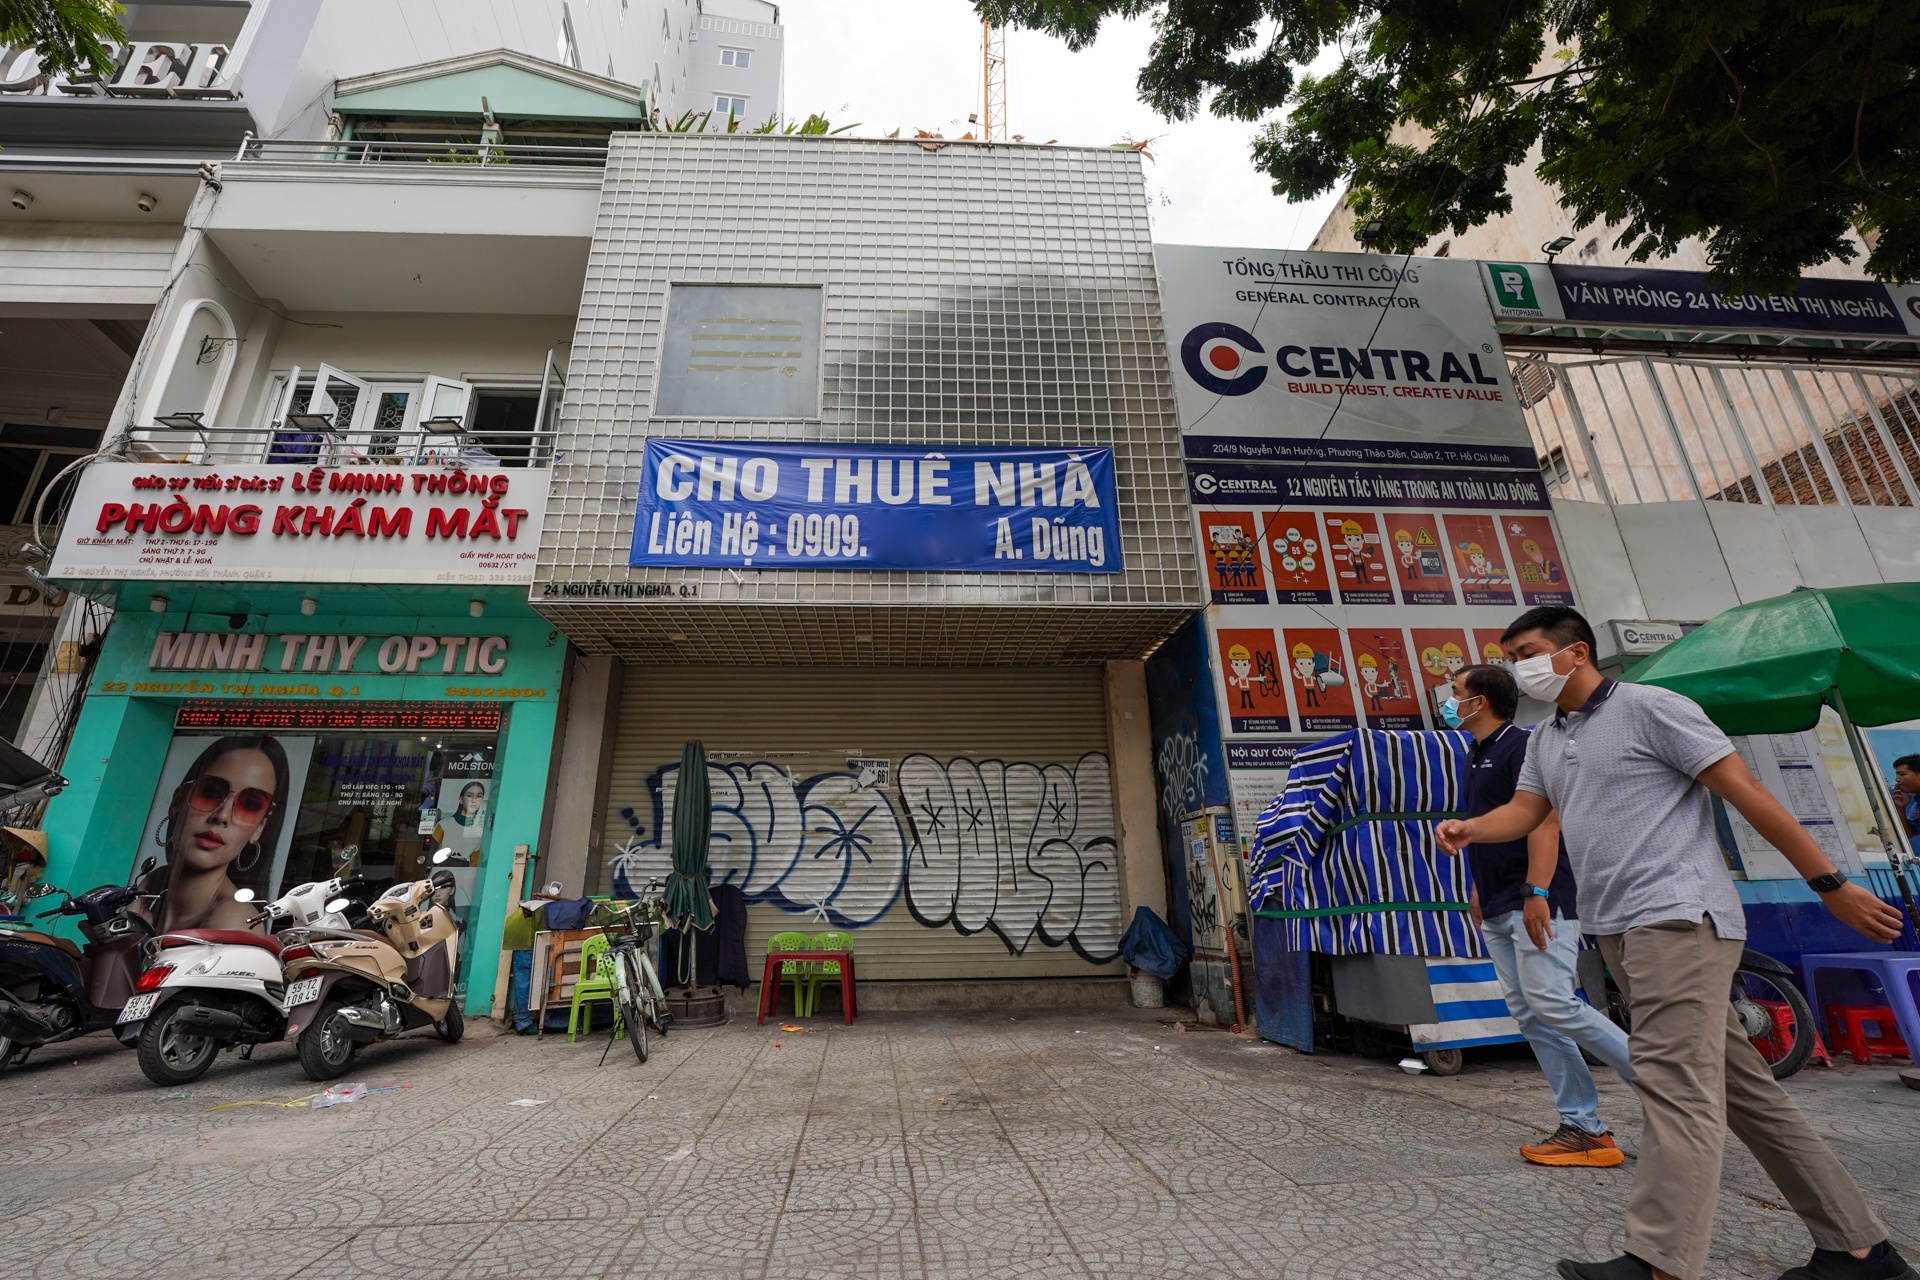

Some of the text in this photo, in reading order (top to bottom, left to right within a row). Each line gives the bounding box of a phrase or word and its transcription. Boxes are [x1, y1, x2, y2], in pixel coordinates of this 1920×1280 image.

[1223, 257, 1419, 283] TỔNG THẦU THI CÔNG
[1236, 290, 1420, 309] GENERAL CONTRACTOR
[1563, 281, 1895, 318] VĂN PHÒNG 24 THỊ NGHĨA
[1501, 308, 1544, 318] PHYTOPHARMA
[1276, 345, 1498, 386] CENTRAL
[1287, 381, 1504, 402] BUILD TRUST, CREATE VALUE
[1212, 444, 1237, 454] 204/9
[1239, 443, 1273, 456] Nguyễn
[1275, 446, 1292, 455] Văn
[1328, 446, 1363, 459] Phường
[1363, 448, 1385, 459] Thảo
[1387, 449, 1410, 460] Điền,
[1411, 450, 1434, 462] Quận
[1435, 451, 1443, 461] 2,
[1444, 452, 1459, 460] TP.
[1460, 451, 1472, 461] Hồ
[1473, 452, 1489, 462] Chí
[1489, 453, 1510, 463] Minh
[168, 476, 191, 490] SƯ
[291, 467, 326, 492] LÊ
[328, 472, 404, 493] MINH
[411, 468, 510, 494] THÔNG
[657, 452, 1101, 509] CHO THUÊ NHÀ
[1219, 479, 1277, 489] CENTRAL
[1286, 471, 1540, 504] 12 NGUYÊN TẮC VÀNG TRONG AN TOÀN LAO ĐỘNG
[96, 493, 529, 540] PHÒNG KHÁM MẮT
[76, 537, 91, 545] GIỜ
[92, 537, 114, 545] KHÁM
[145, 537, 160, 545] THỨ
[169, 538, 184, 546] THỨ
[648, 510, 710, 556] Liên
[720, 511, 760, 566] Hệ
[995, 518, 1024, 559] A.
[1032, 517, 1105, 567] Dũng
[142, 546, 161, 555] SÁNG
[163, 547, 179, 555] THỨ
[459, 550, 536, 561] GIẤY PHÉP HOẠT ĐỘNG
[1291, 546, 1301, 555] 5S
[139, 556, 154, 564] CHỦ
[155, 556, 174, 565] NHẬT
[62, 567, 75, 575] 22
[78, 566, 111, 576] NGUYỄN
[114, 568, 129, 578] THỊ
[543, 584, 558, 596] 24
[563, 580, 610, 596] NGUYỄN
[613, 584, 633, 597] THỊ
[1291, 592, 1297, 602] 2
[1344, 593, 1350, 602] 3
[1413, 594, 1418, 603] 4
[1467, 594, 1472, 603] 5
[1534, 594, 1540, 603] 6
[1640, 633, 1677, 641] CENTRAL
[148, 632, 508, 674] MINH THY OPTIC
[101, 681, 128, 692] 22
[132, 679, 215, 694] NGUYỄN
[220, 684, 254, 696] THỊ
[259, 683, 319, 695] NGHĨA
[444, 686, 547, 698] 38322804
[181, 713, 220, 725] MINH
[224, 713, 251, 726] THY
[252, 714, 296, 726] OPTIC
[300, 714, 326, 726] TRY
[328, 714, 358, 727] OUR
[361, 715, 397, 727] BEST
[400, 715, 419, 727] TO
[422, 715, 467, 727] SERVE
[1243, 720, 1247, 730] 7
[1306, 718, 1312, 729] 8
[1380, 717, 1386, 728] 9
[1231, 747, 1248, 759] NỘI
[1251, 748, 1270, 758] QUY
[448, 762, 495, 771] MOLSION
[291, 978, 318, 994] 59-T2
[286, 989, 318, 1006] 108.49
